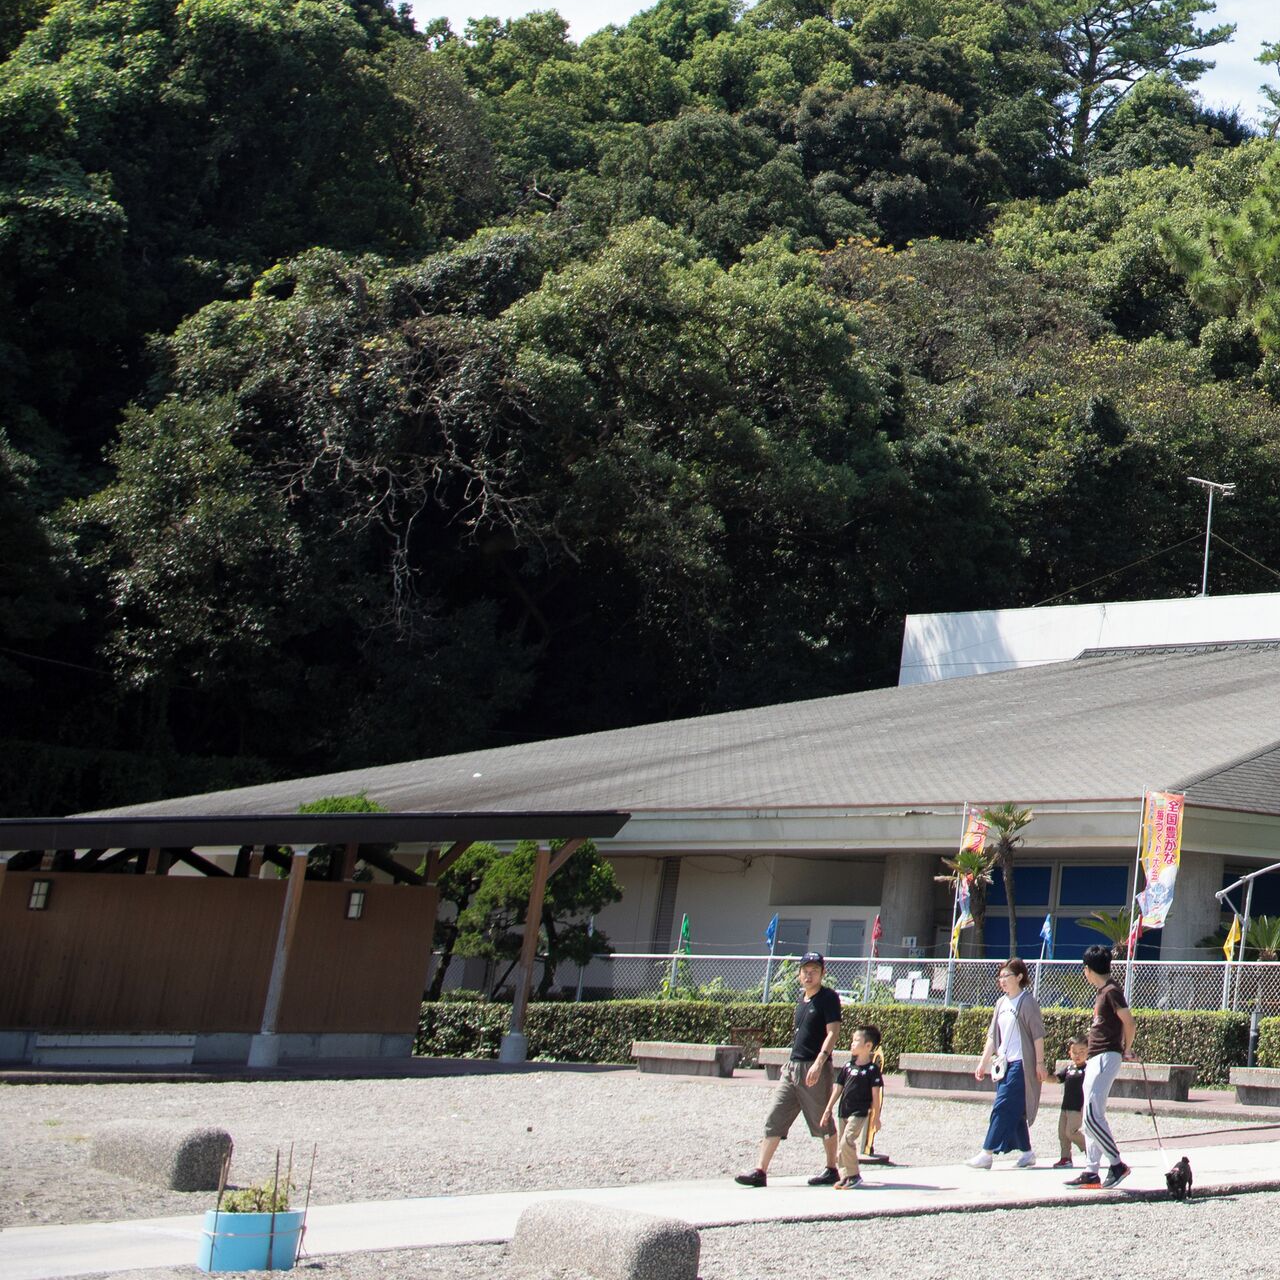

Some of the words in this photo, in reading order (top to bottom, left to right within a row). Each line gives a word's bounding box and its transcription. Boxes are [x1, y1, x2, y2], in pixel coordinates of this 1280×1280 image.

[1164, 800, 1179, 865] 全国豊かな
